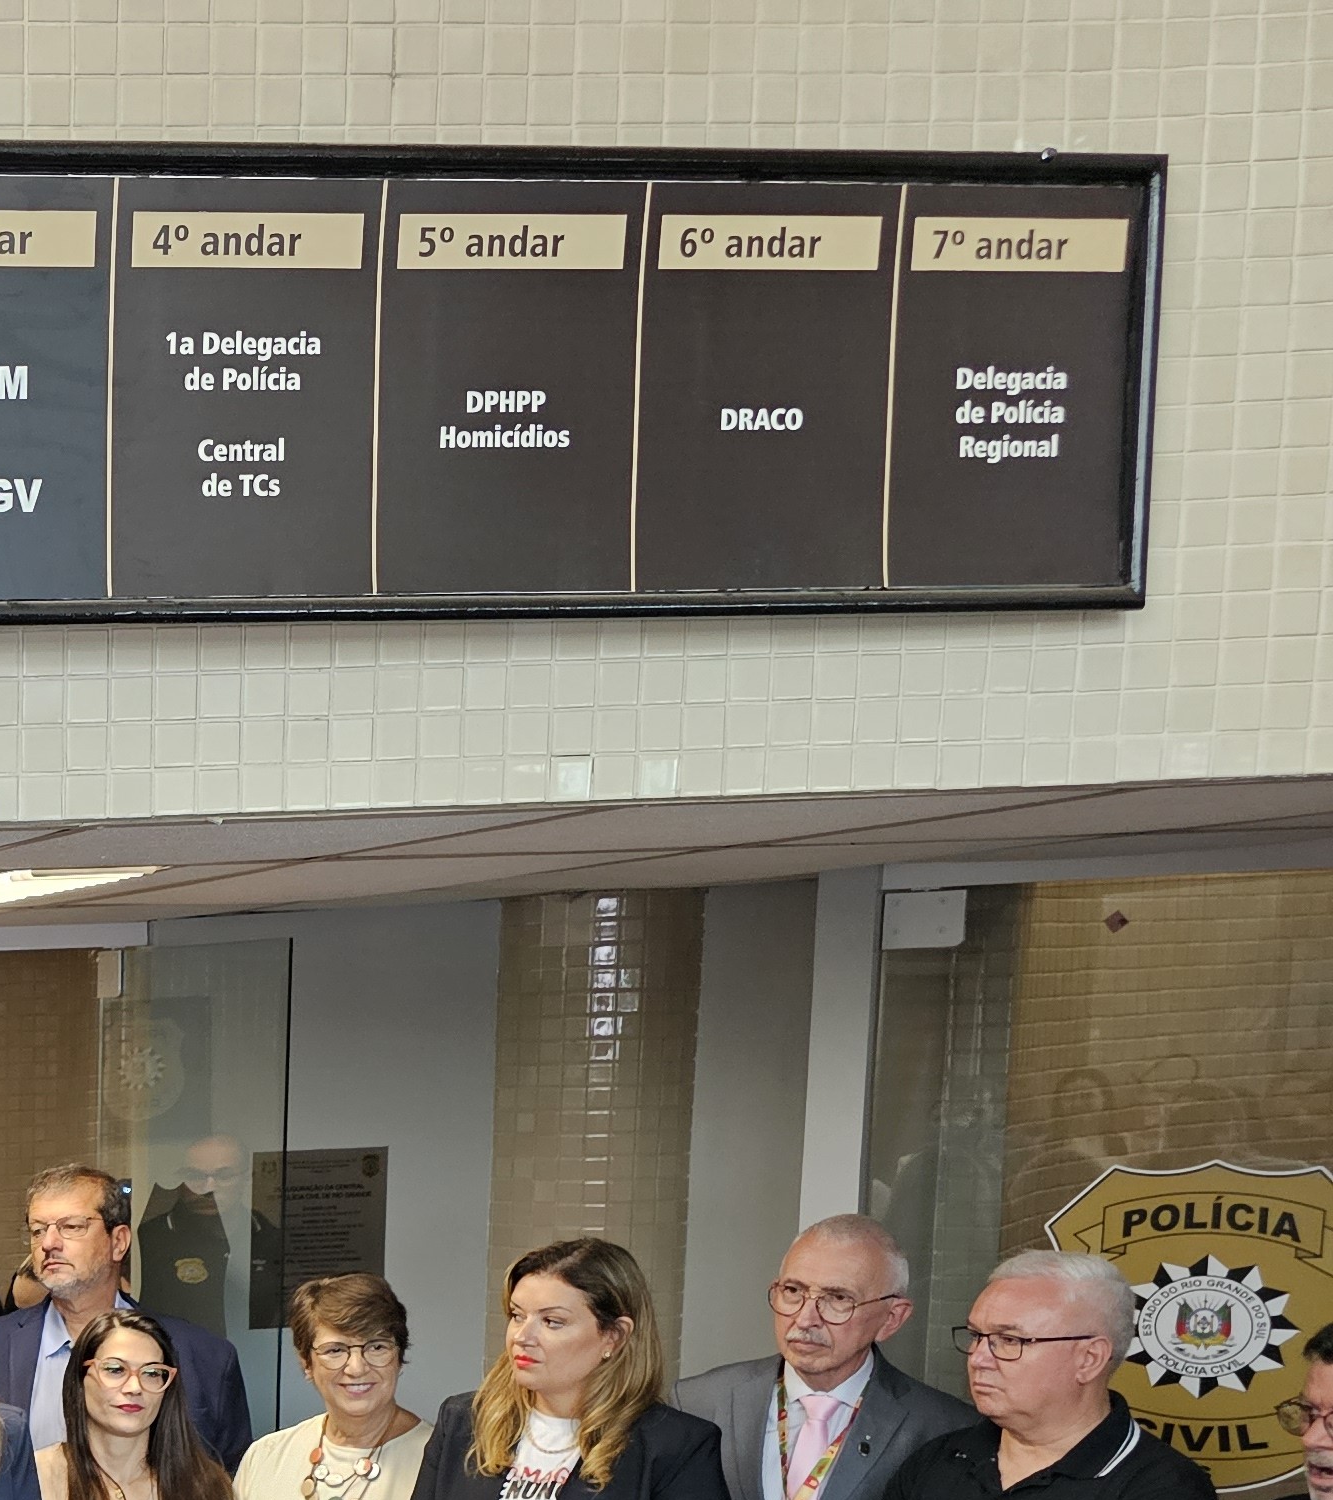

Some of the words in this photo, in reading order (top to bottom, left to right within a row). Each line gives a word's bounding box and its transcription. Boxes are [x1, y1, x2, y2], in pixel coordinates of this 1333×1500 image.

[200, 223, 302, 257] andar
[465, 224, 565, 258] andar
[725, 226, 822, 259] andar
[975, 228, 1069, 261] andar
[165, 331, 195, 355] 1a
[202, 330, 321, 362] Delegacia
[184, 366, 215, 391] de
[222, 365, 301, 391] Polícia
[955, 365, 1068, 396] Delegacia
[466, 390, 547, 414] DPHPP
[955, 399, 986, 425] de
[990, 399, 1065, 424] Polícia
[720, 407, 804, 431] DRACO
[439, 423, 570, 449] Homicídios
[959, 433, 1060, 464] Regional
[197, 437, 285, 462] Central
[201, 472, 233, 497] de
[238, 473, 281, 497] TCs
[1122, 1195, 1302, 1244] POLÍCIA
[1161, 1286, 1178, 1299] DO
[1180, 1279, 1202, 1290] RIO
[1206, 1279, 1255, 1304] GRANDE
[1142, 1298, 1162, 1336] ESTADO
[1251, 1304, 1264, 1320] DO
[1254, 1322, 1267, 1341] SUL
[1158, 1353, 1208, 1376] POLÍCIA
[1211, 1359, 1245, 1374] CIVIL
